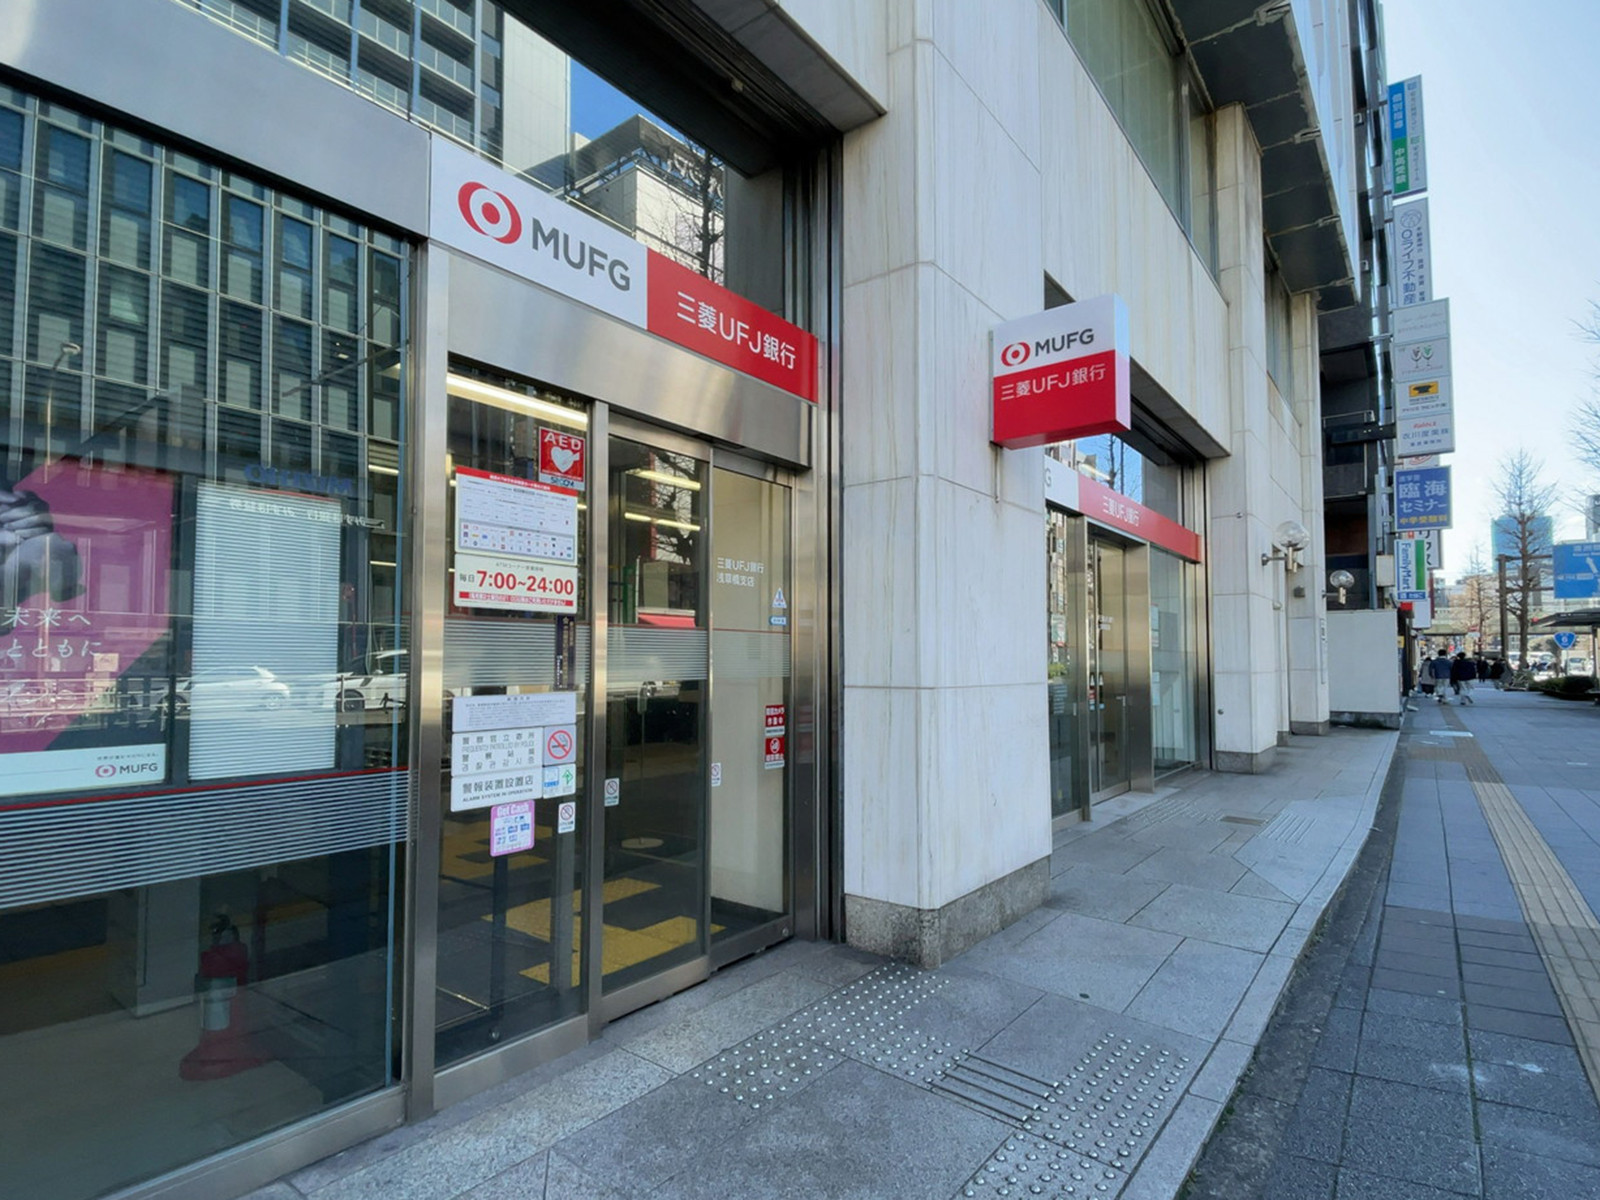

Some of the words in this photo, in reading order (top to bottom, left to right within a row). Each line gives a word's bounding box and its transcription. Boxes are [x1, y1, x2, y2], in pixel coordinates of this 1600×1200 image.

[532, 217, 630, 292] MUFG
[677, 290, 796, 369] 三菱UFJ銀行
[1035, 328, 1095, 357] MUFG
[1001, 363, 1106, 400] 三菱UFJ銀行
[544, 432, 582, 451] AED
[1399, 481, 1448, 499] 臨海
[1400, 499, 1448, 513] セミナー
[1400, 542, 1412, 590] FamilyMart
[459, 573, 475, 583] 毎日
[1, 607, 91, 628] 未来へ
[119, 762, 158, 775] MUFG
[463, 775, 534, 794] 警報装置設置店
[482, 792, 501, 800] SYSTEM
[508, 787, 533, 796] OPERATION
